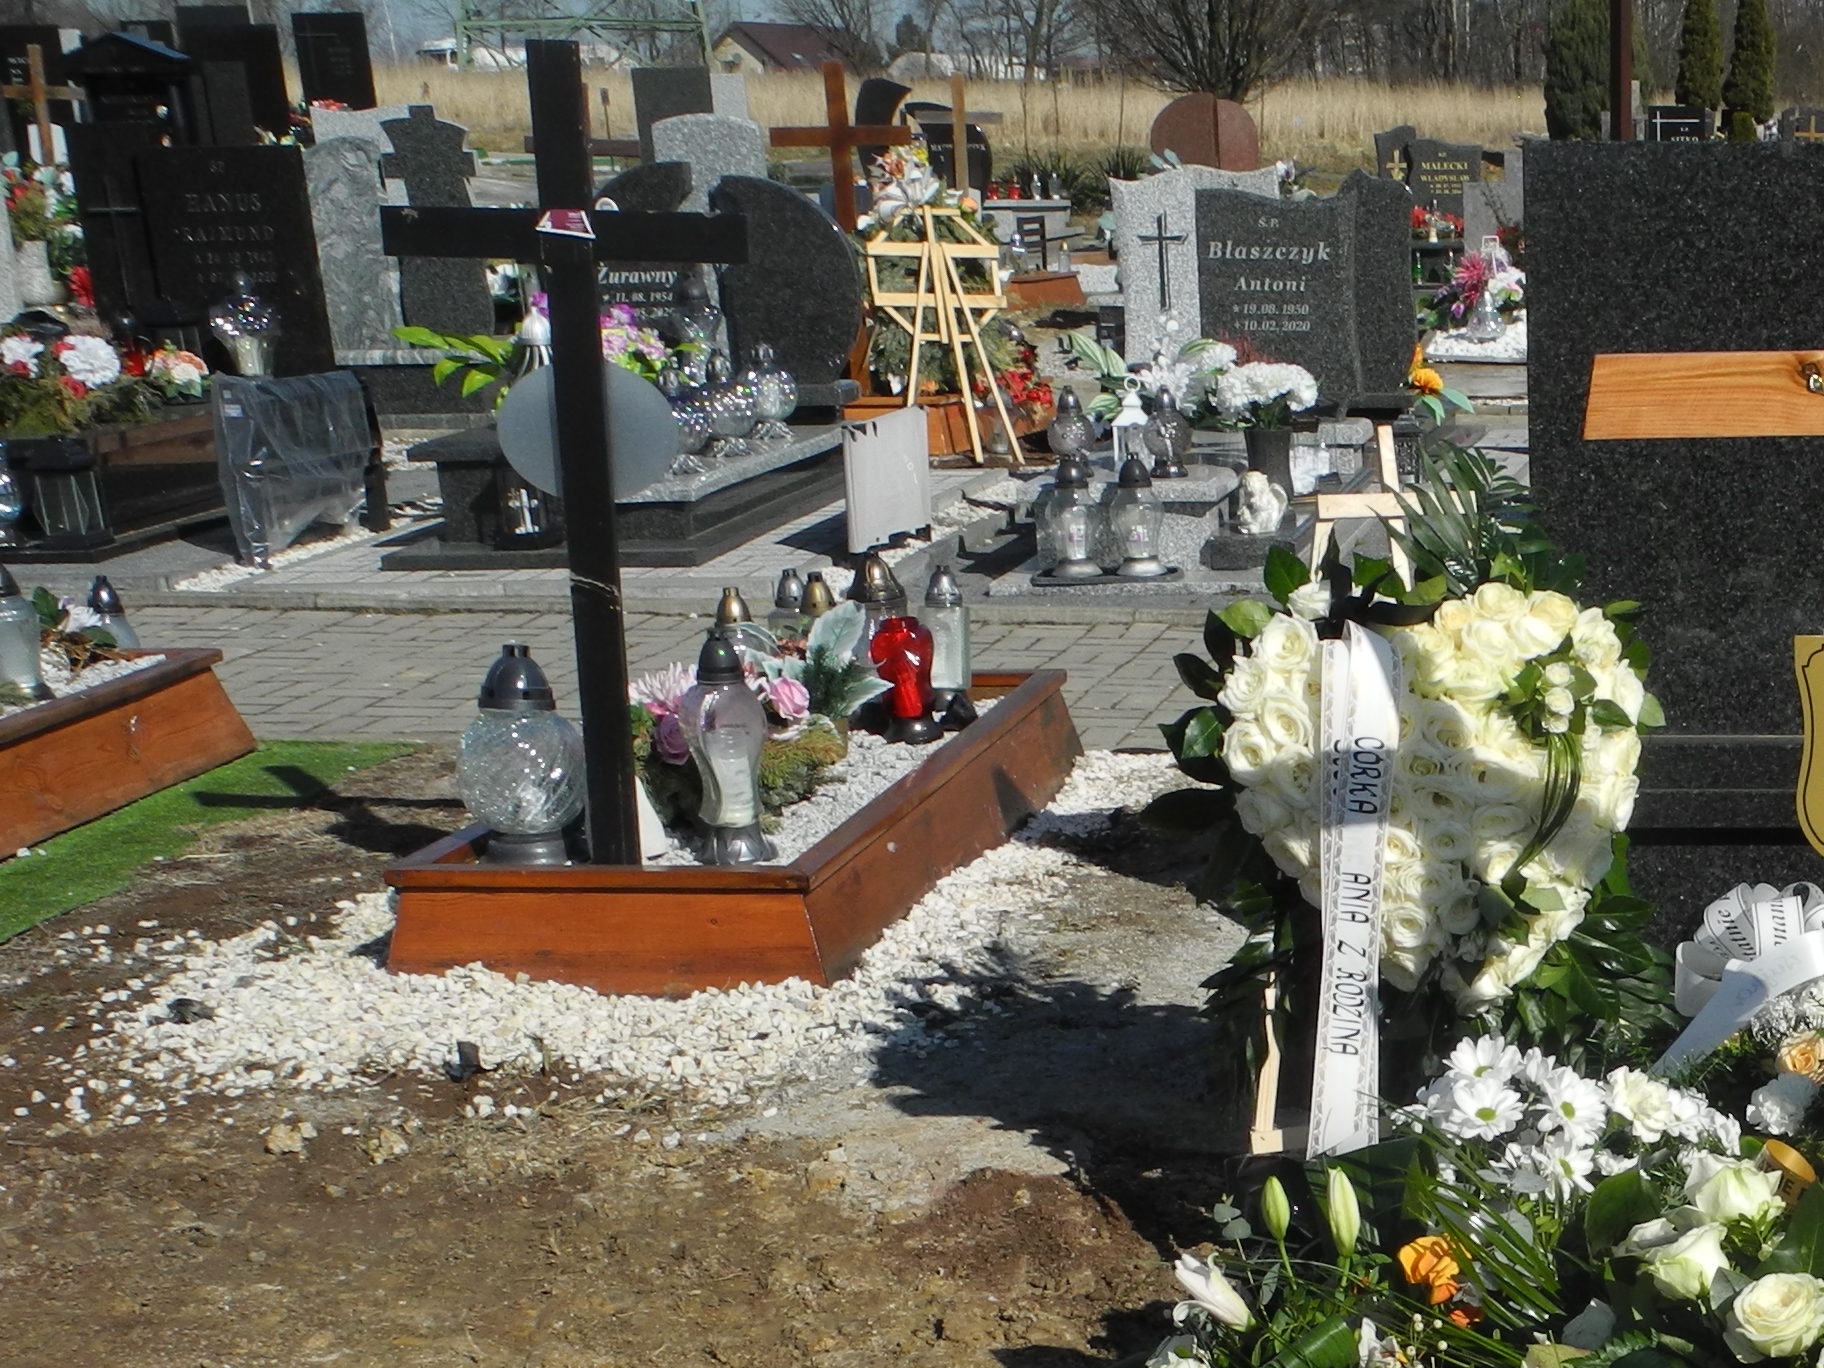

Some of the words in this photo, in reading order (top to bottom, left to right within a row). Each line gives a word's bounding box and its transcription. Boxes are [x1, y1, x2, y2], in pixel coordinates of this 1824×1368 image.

[1421, 161, 1469, 170] MALECKI
[184, 193, 263, 213] HANUS
[1208, 240, 1331, 265] Błaszczyk
[597, 261, 678, 287] Żurawny
[1234, 276, 1307, 292] Antoni
[1338, 872, 1372, 924] ANIA
[1337, 940, 1367, 959] Z
